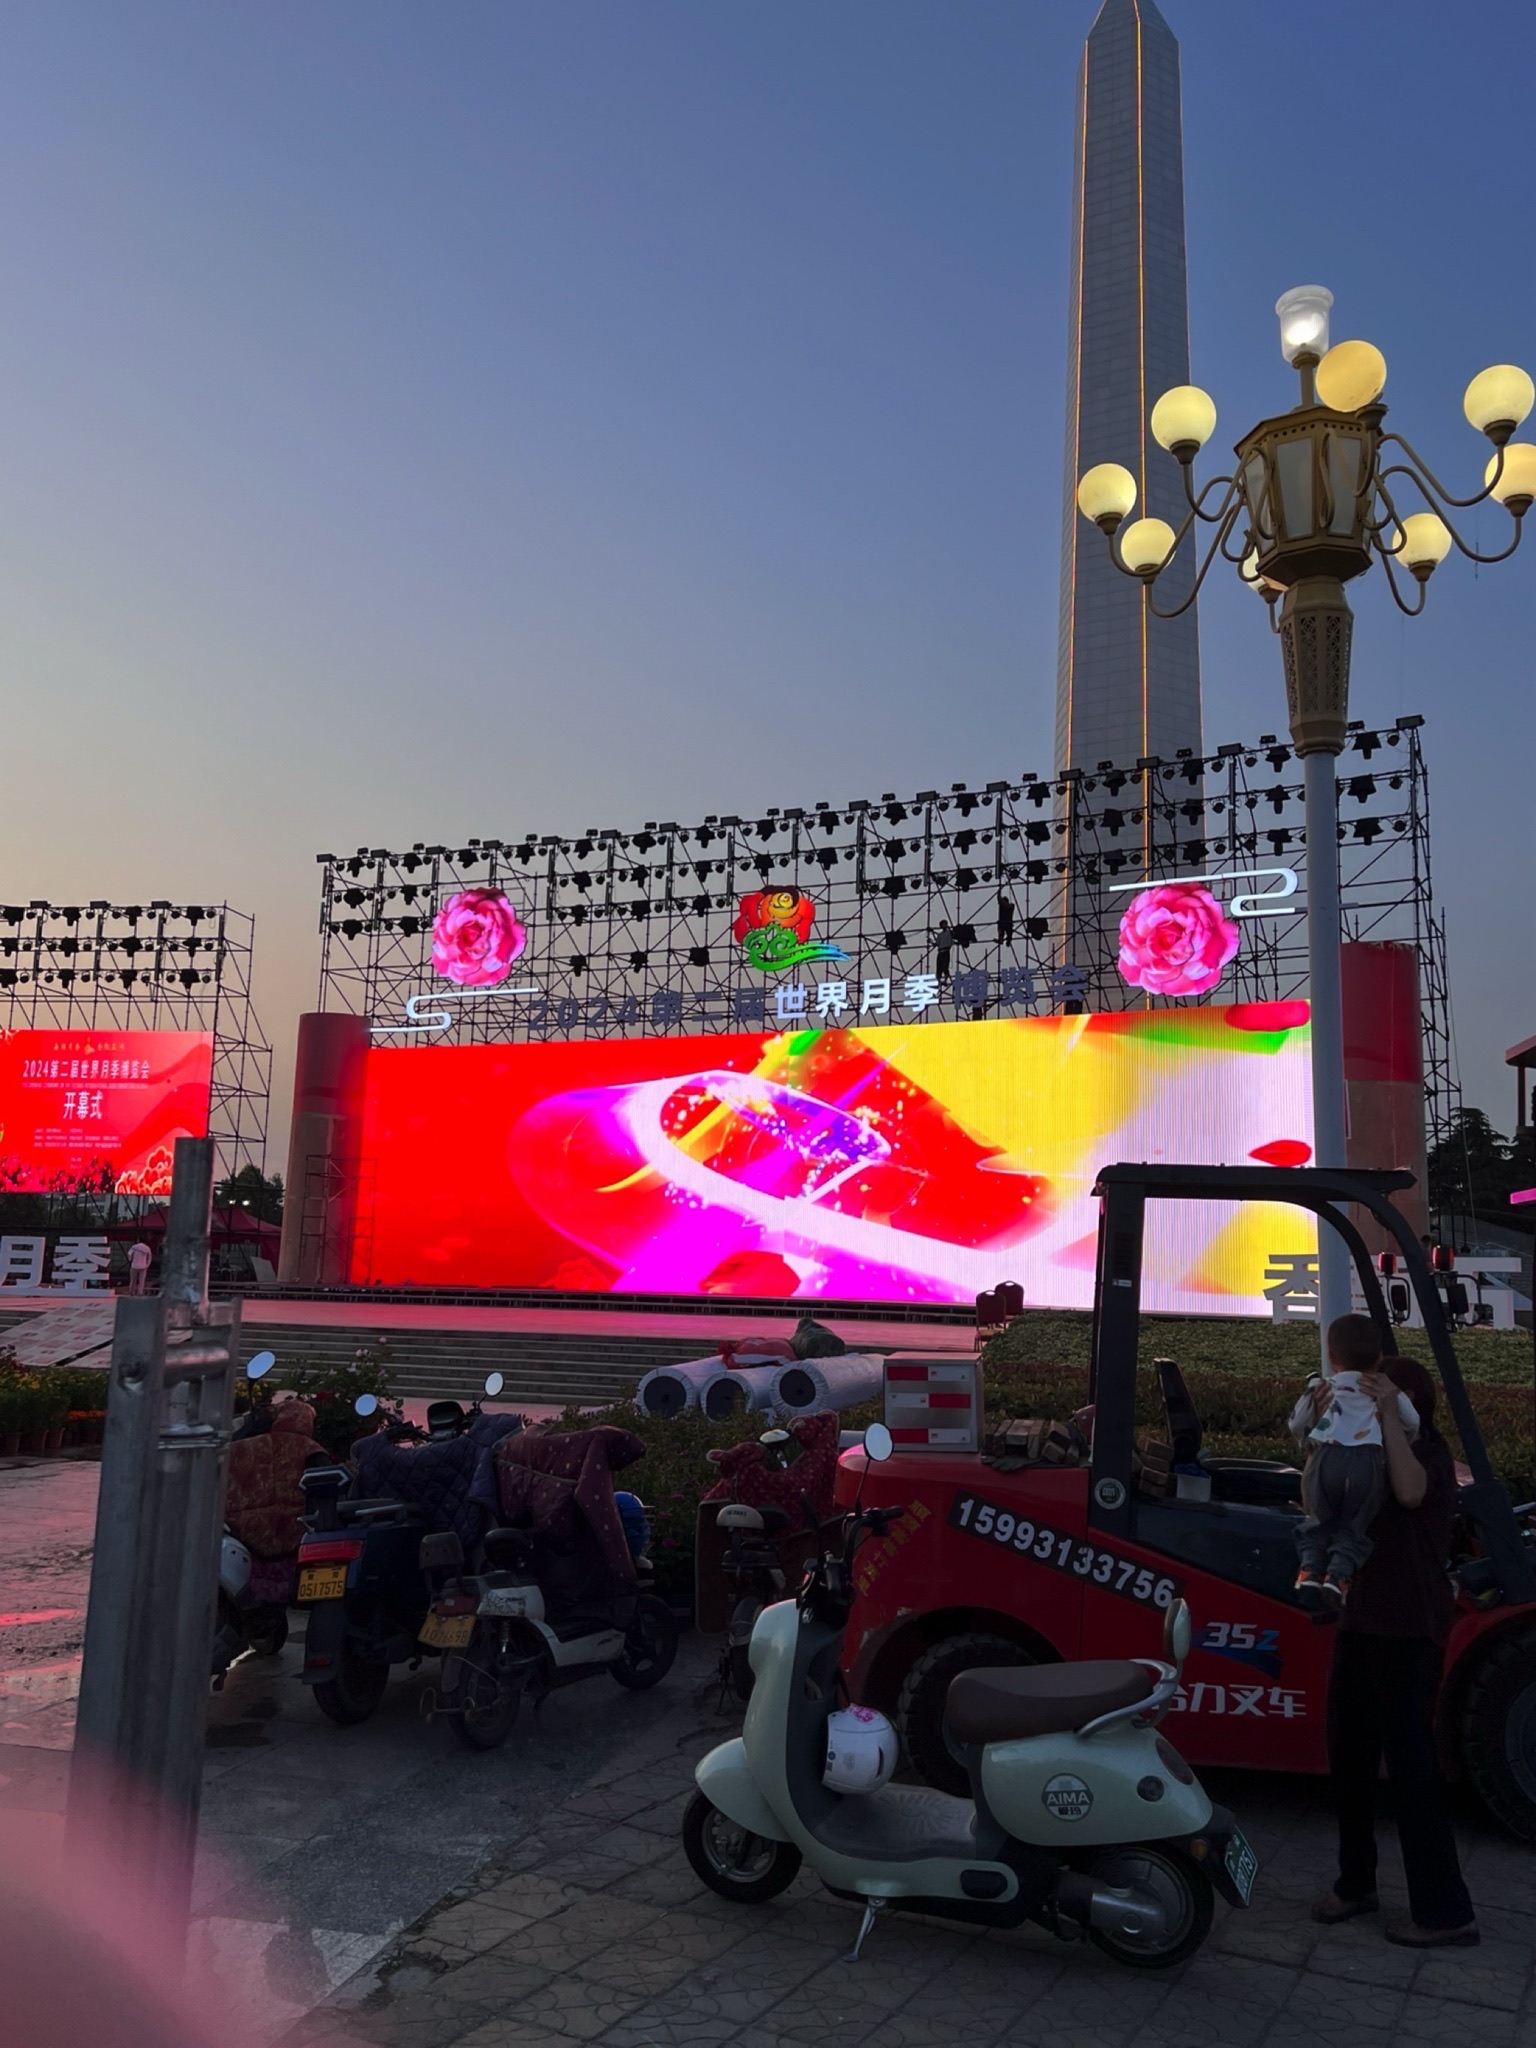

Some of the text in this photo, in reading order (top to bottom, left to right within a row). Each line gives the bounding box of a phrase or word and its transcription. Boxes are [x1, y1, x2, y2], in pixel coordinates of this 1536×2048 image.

[23, 1060, 150, 1079] 2024第二届世界月季博览会
[62, 1090, 104, 1120] 开幕式
[0, 1236, 111, 1288] 月季
[959, 1499, 1175, 1607] 15993133756
[300, 1581, 343, 1597] 0517575
[1046, 1791, 1090, 1805] AIMA
